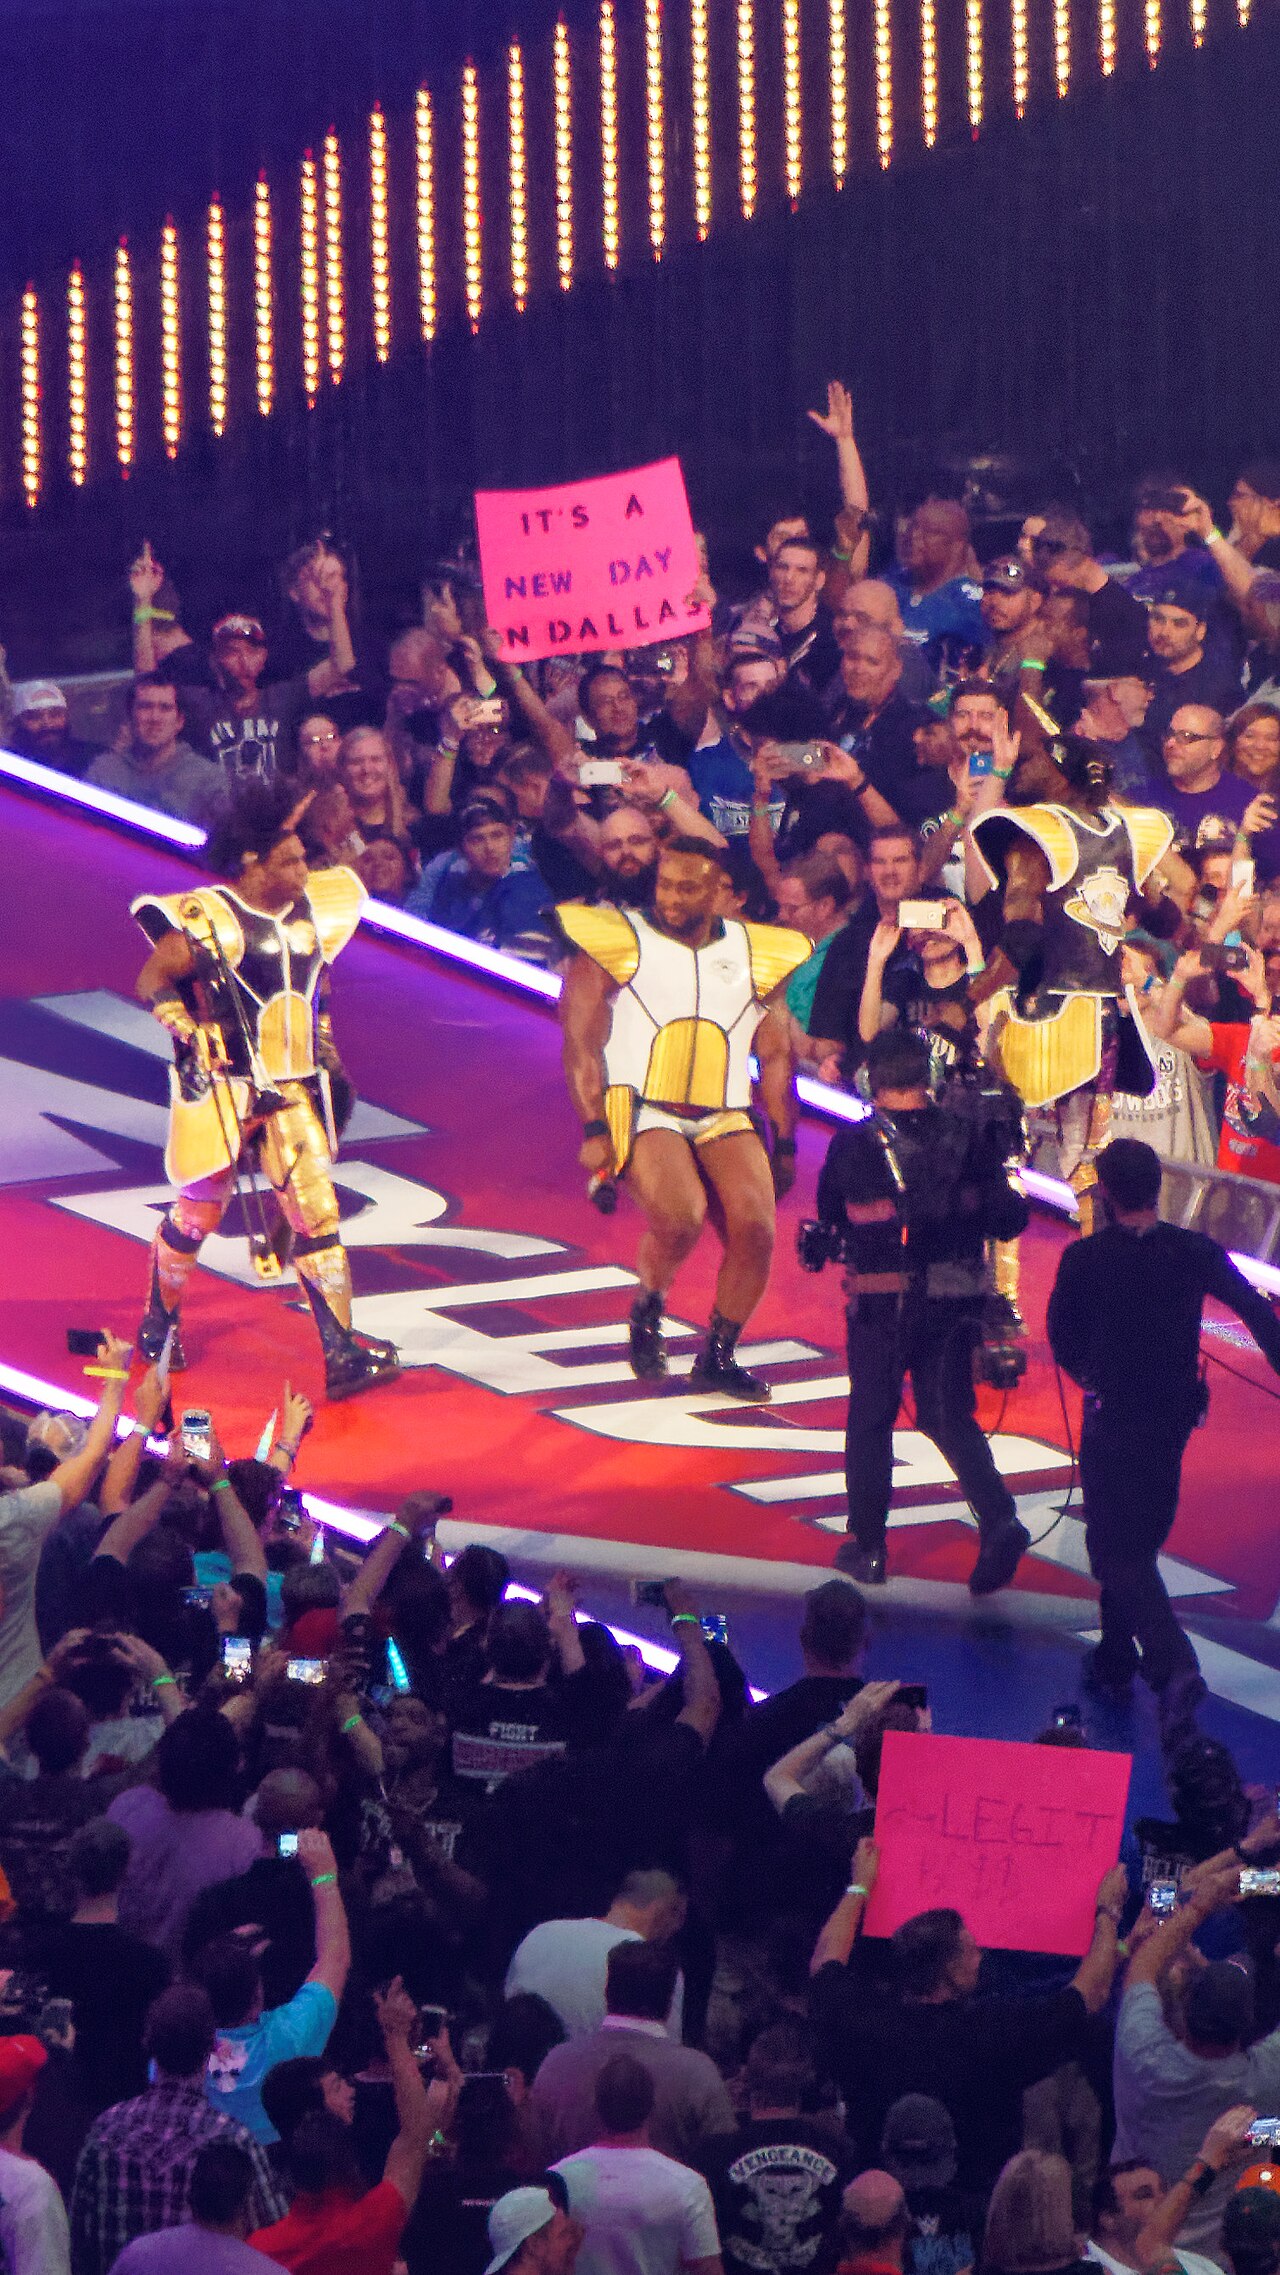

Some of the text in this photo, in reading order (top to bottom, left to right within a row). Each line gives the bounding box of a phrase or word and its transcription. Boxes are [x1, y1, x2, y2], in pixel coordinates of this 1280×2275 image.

[520, 493, 645, 535] IT'S A
[504, 546, 673, 599] NEW DAY
[940, 1792, 1116, 1850] LEGIT
